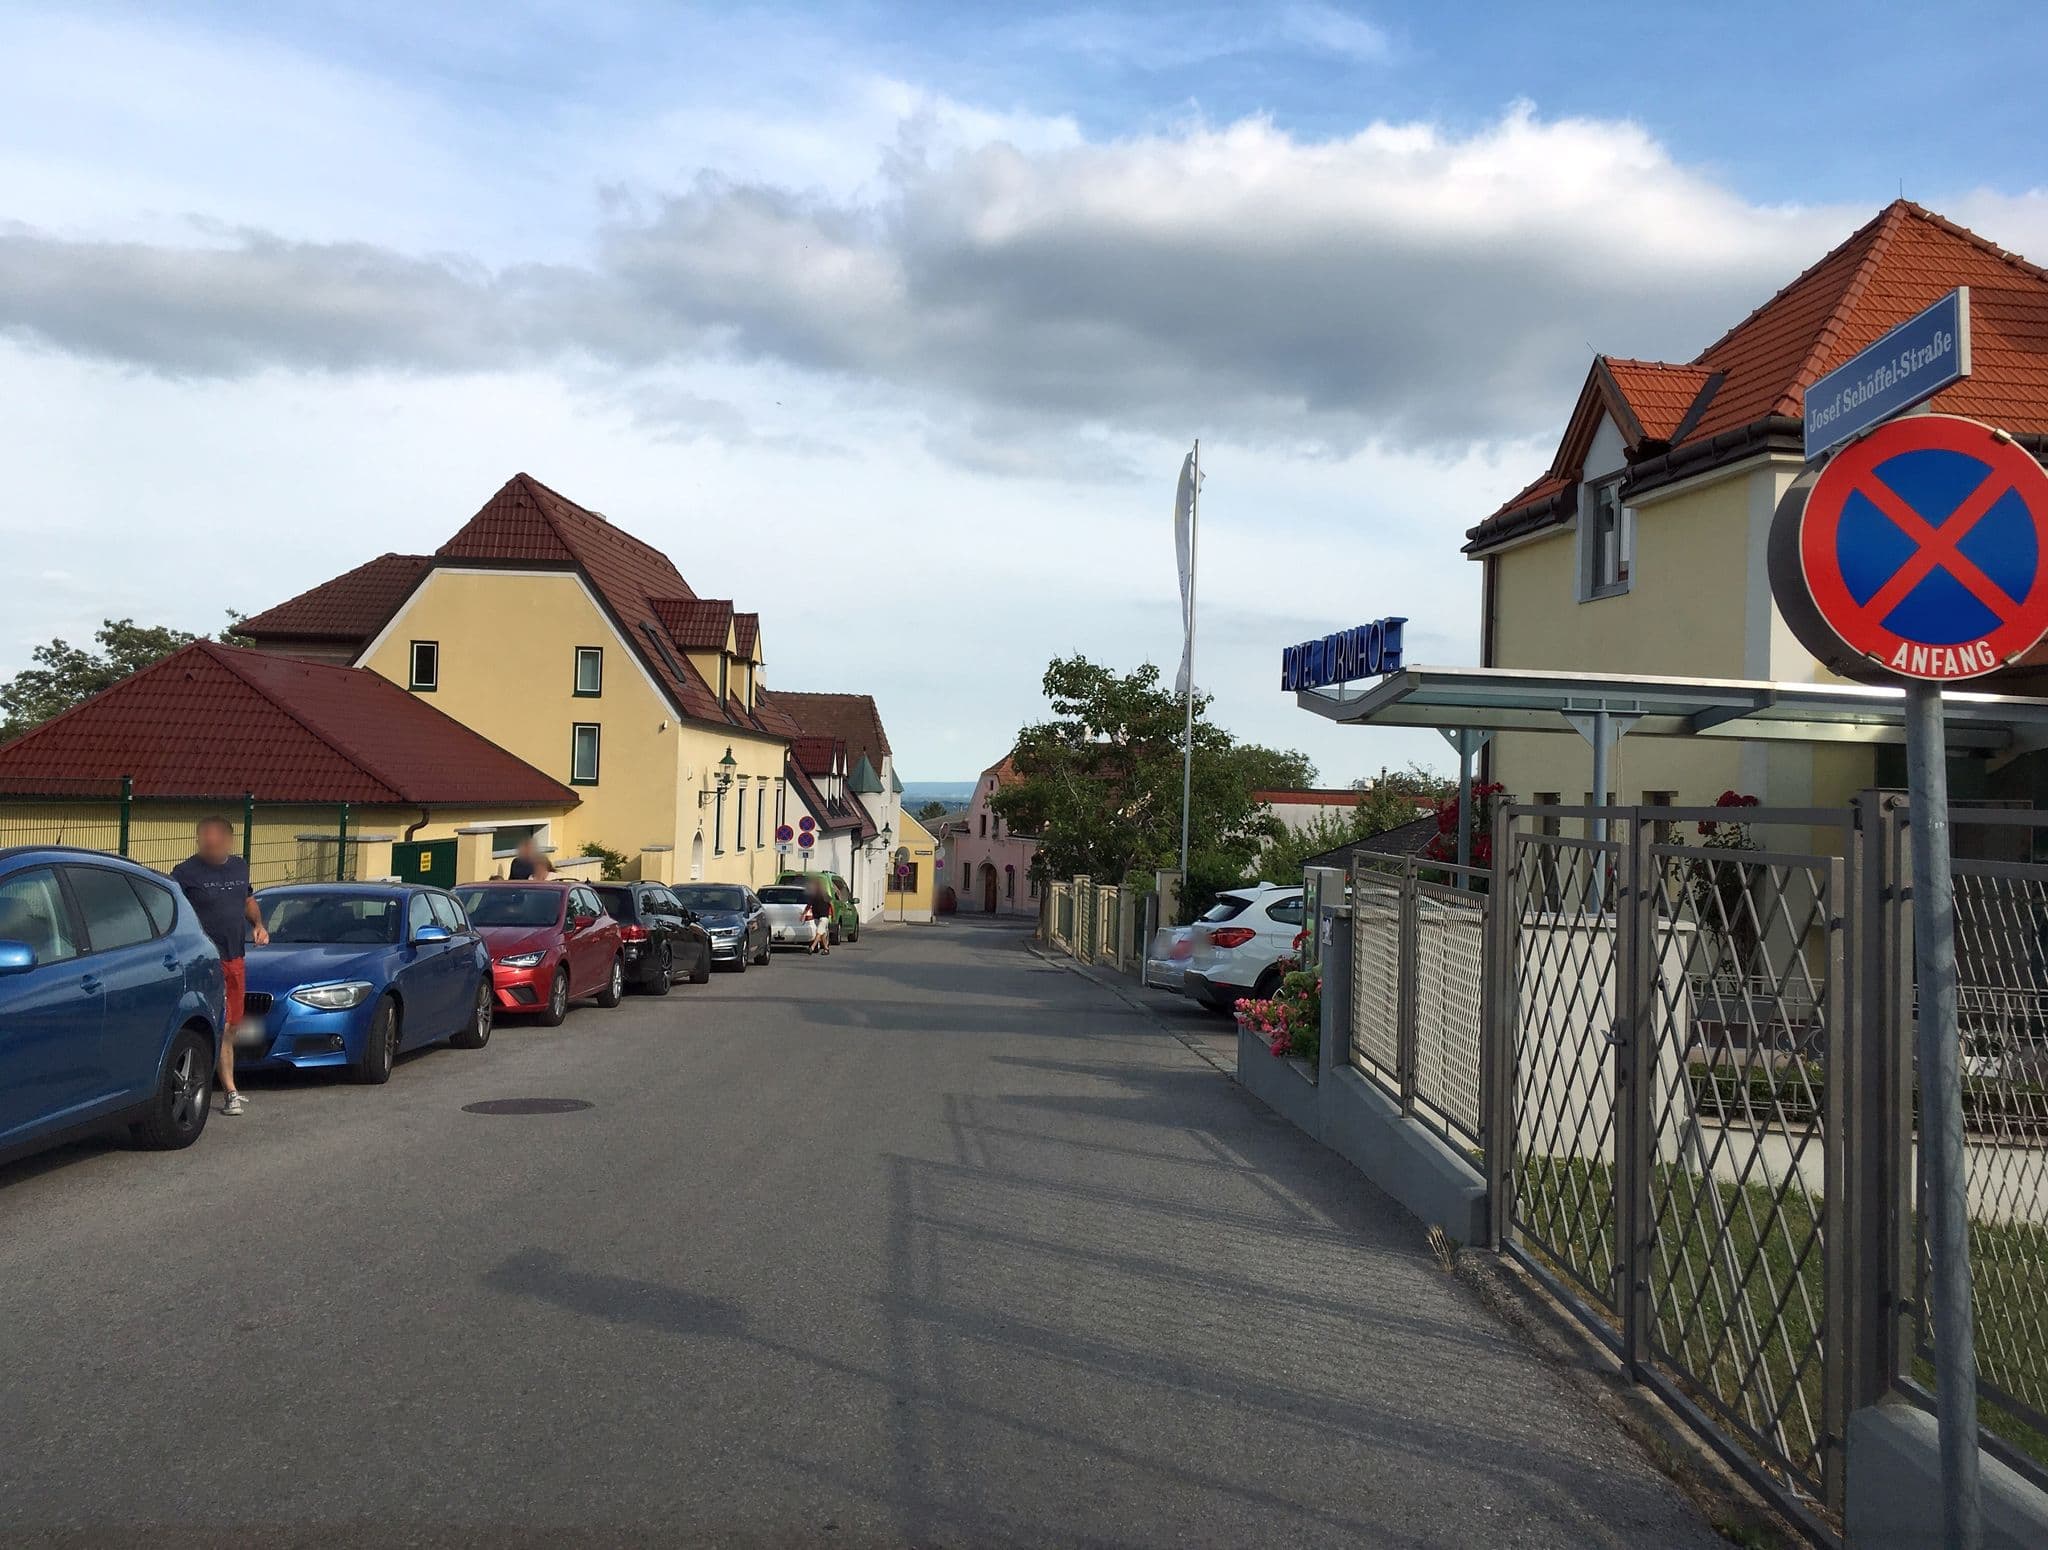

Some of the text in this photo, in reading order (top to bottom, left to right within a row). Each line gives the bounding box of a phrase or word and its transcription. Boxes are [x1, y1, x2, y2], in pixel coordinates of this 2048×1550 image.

[1809, 330, 1952, 433] Josef Schöffel-Straße
[1281, 617, 1409, 692] HOTEL TURMHOF
[1890, 640, 1995, 676] ANFANG
